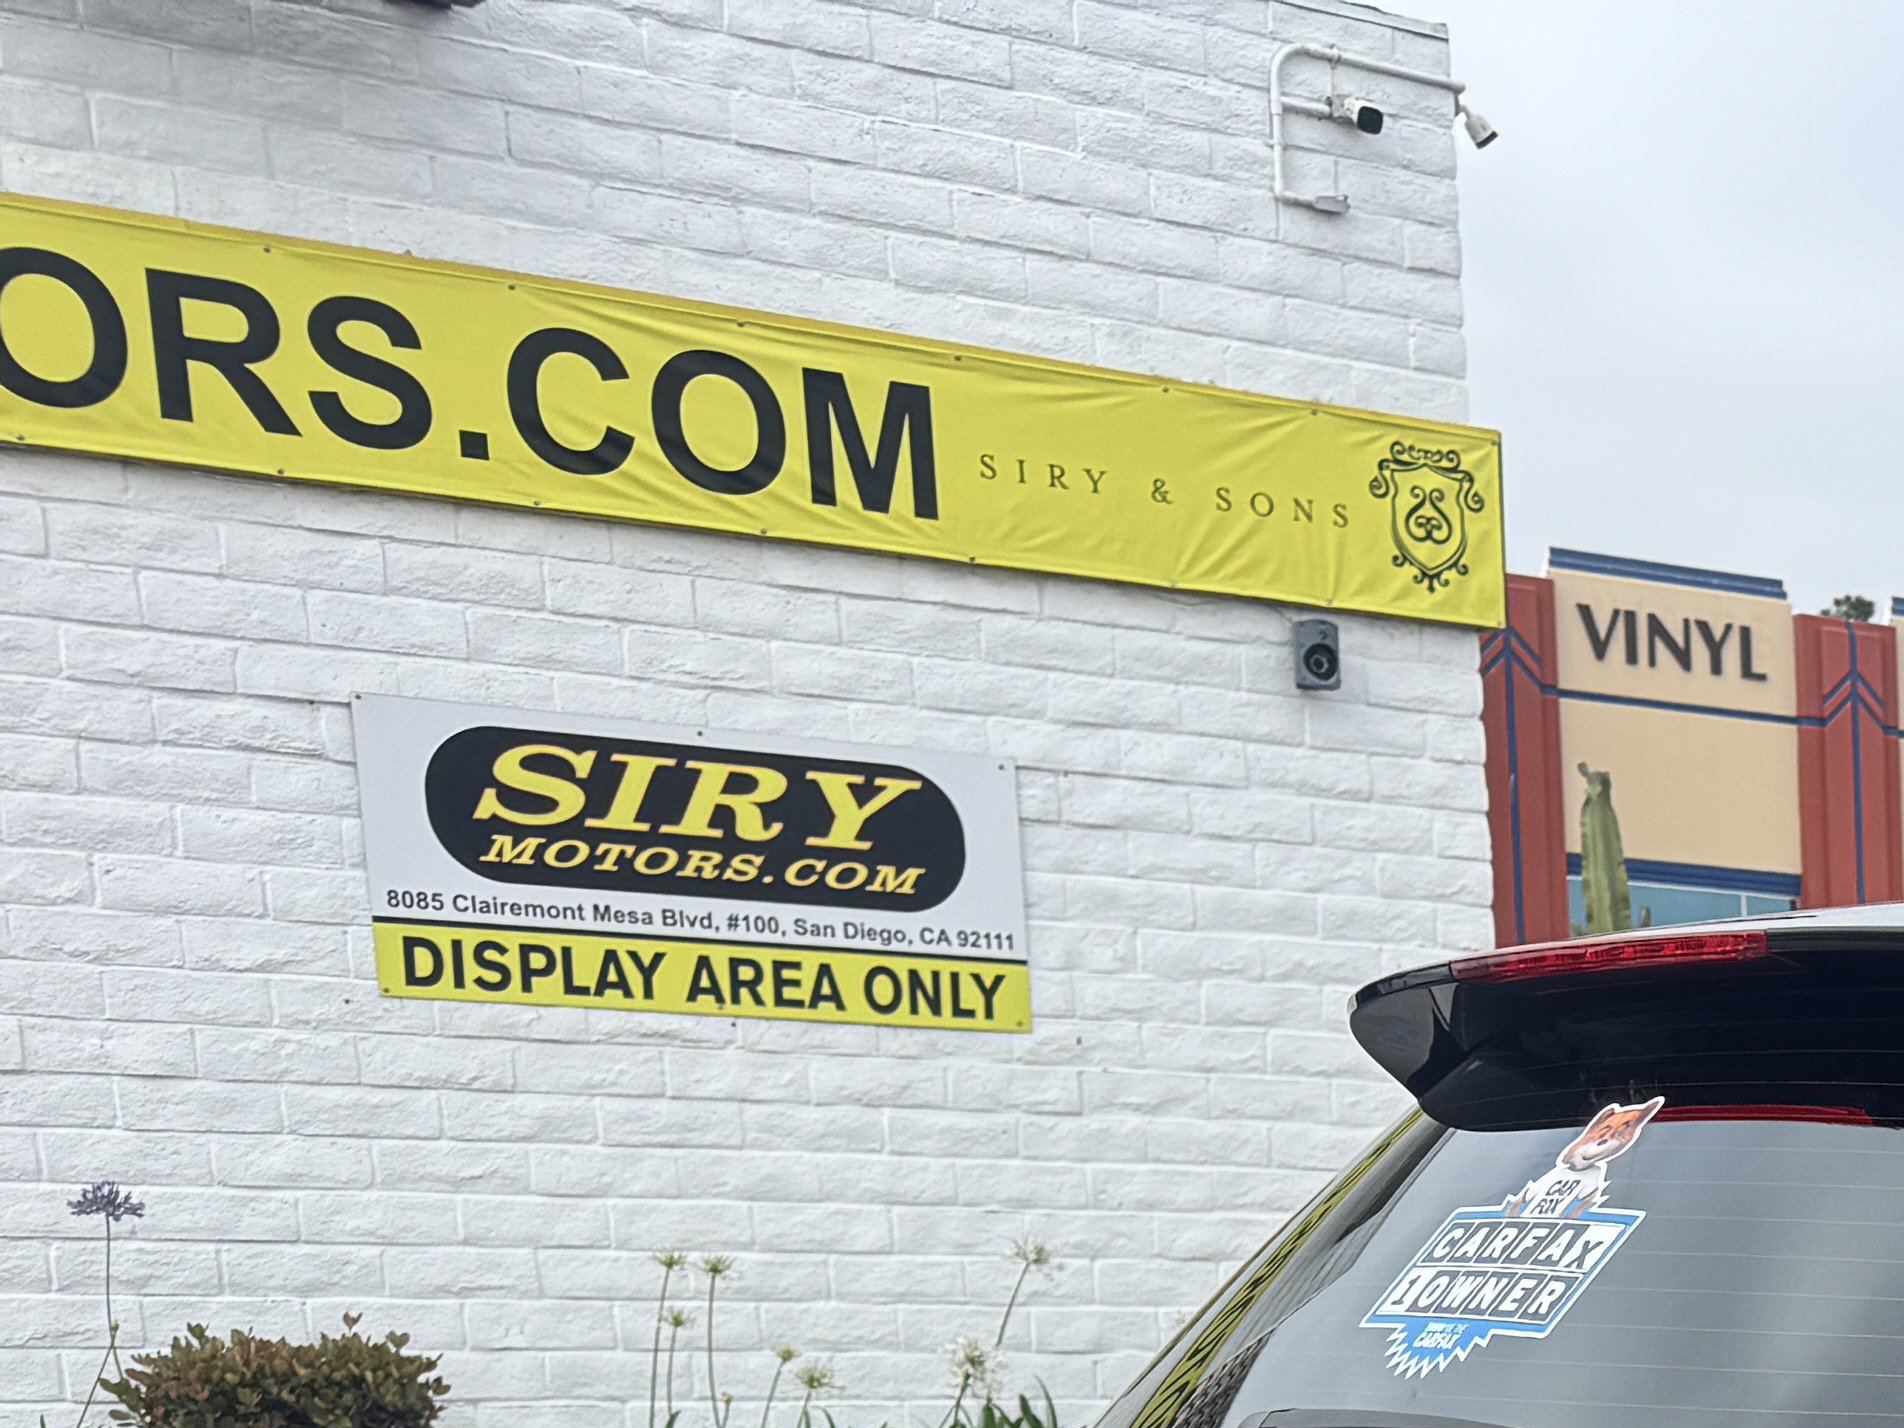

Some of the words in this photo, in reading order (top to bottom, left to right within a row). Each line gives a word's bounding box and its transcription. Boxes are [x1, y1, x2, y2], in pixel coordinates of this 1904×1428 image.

[979, 453, 1107, 495] SIRY
[1150, 478, 1174, 505] &
[1215, 486, 1350, 529] SONS
[1576, 602, 1767, 682] VINYL
[472, 743, 924, 851] SIRY
[479, 834, 926, 895] MOTORS.COM
[386, 889, 445, 912] 8085
[452, 893, 587, 922] Clairemont
[593, 904, 654, 927] Mesa
[662, 908, 720, 933] Blvd,
[726, 913, 787, 937] #100,
[793, 918, 836, 939] San
[843, 921, 914, 947] Diego,
[919, 926, 951, 947] CA
[956, 931, 1016, 952] 92111
[402, 935, 668, 1000] DISPLAY
[685, 954, 847, 1012] AREA
[863, 965, 1007, 1020] ONLY
[1432, 1227, 1605, 1270] CARFAX
[1423, 1274, 1567, 1315] OWNER
